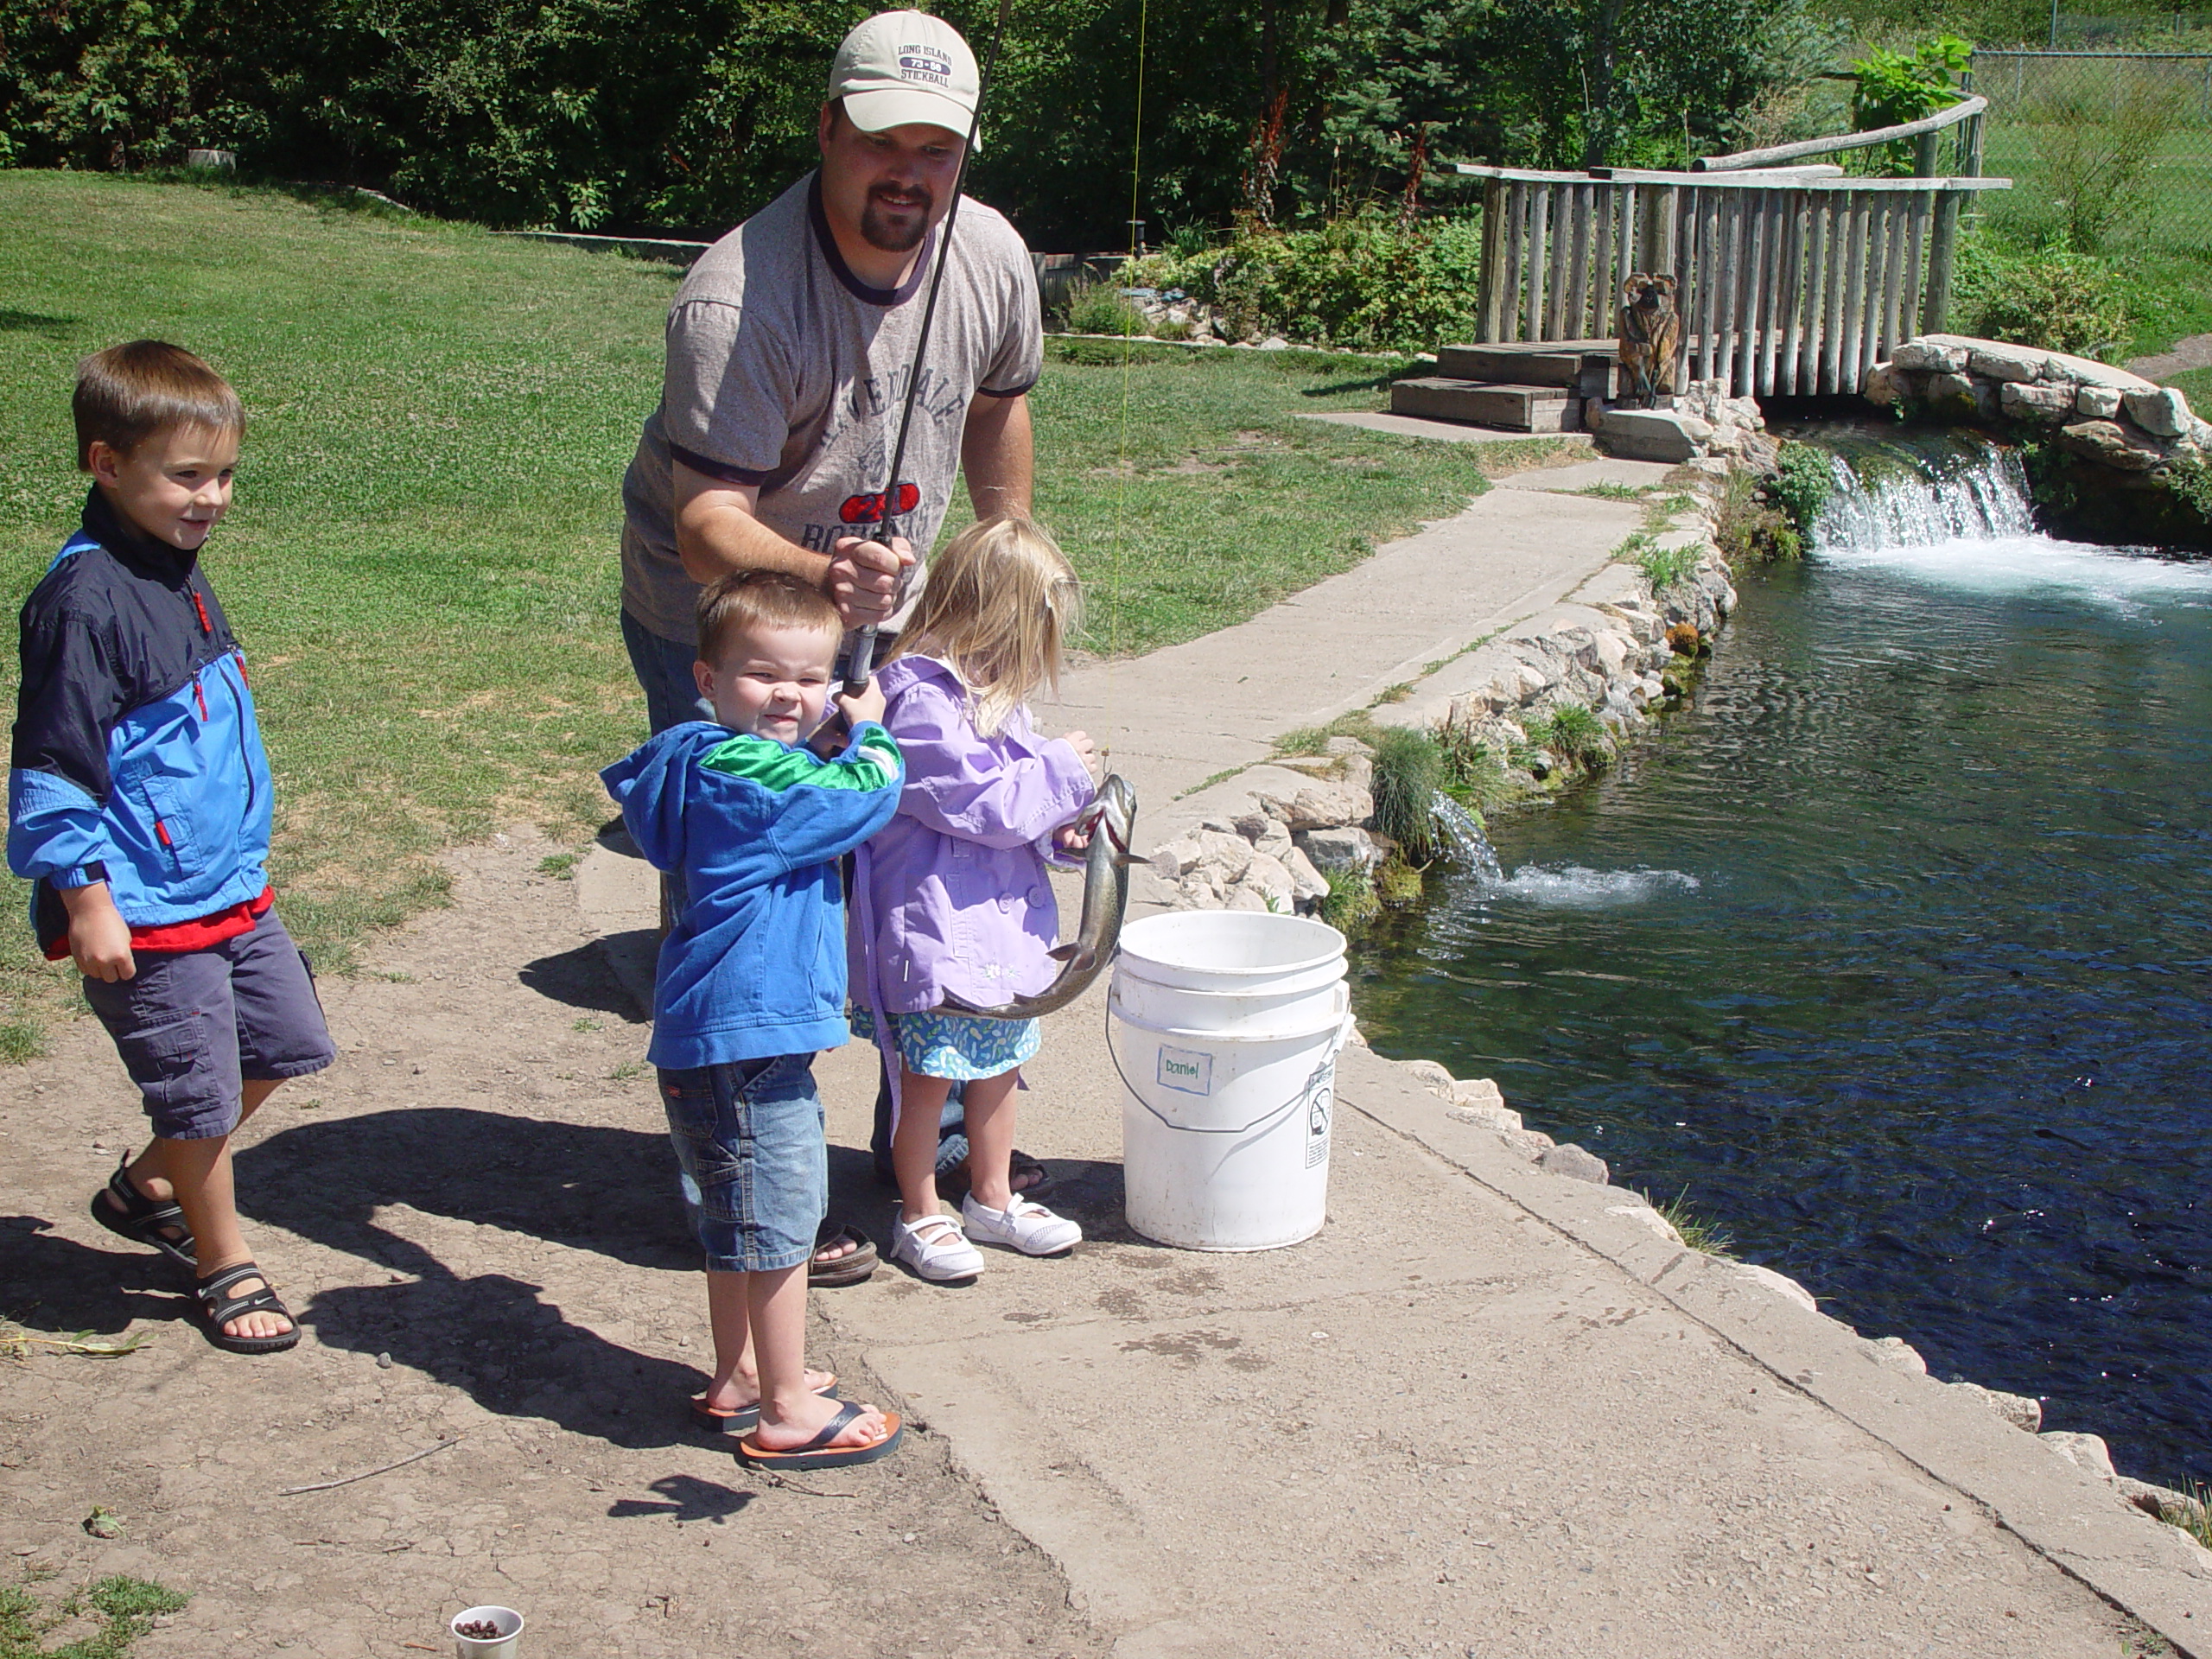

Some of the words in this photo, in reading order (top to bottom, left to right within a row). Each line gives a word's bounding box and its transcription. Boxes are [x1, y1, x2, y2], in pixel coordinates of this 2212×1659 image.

[899, 45, 920, 54] LONG
[924, 47, 951, 65] ISLAND
[901, 69, 949, 87] STICKBALL
[1166, 1059, 1199, 1079] Daniel
